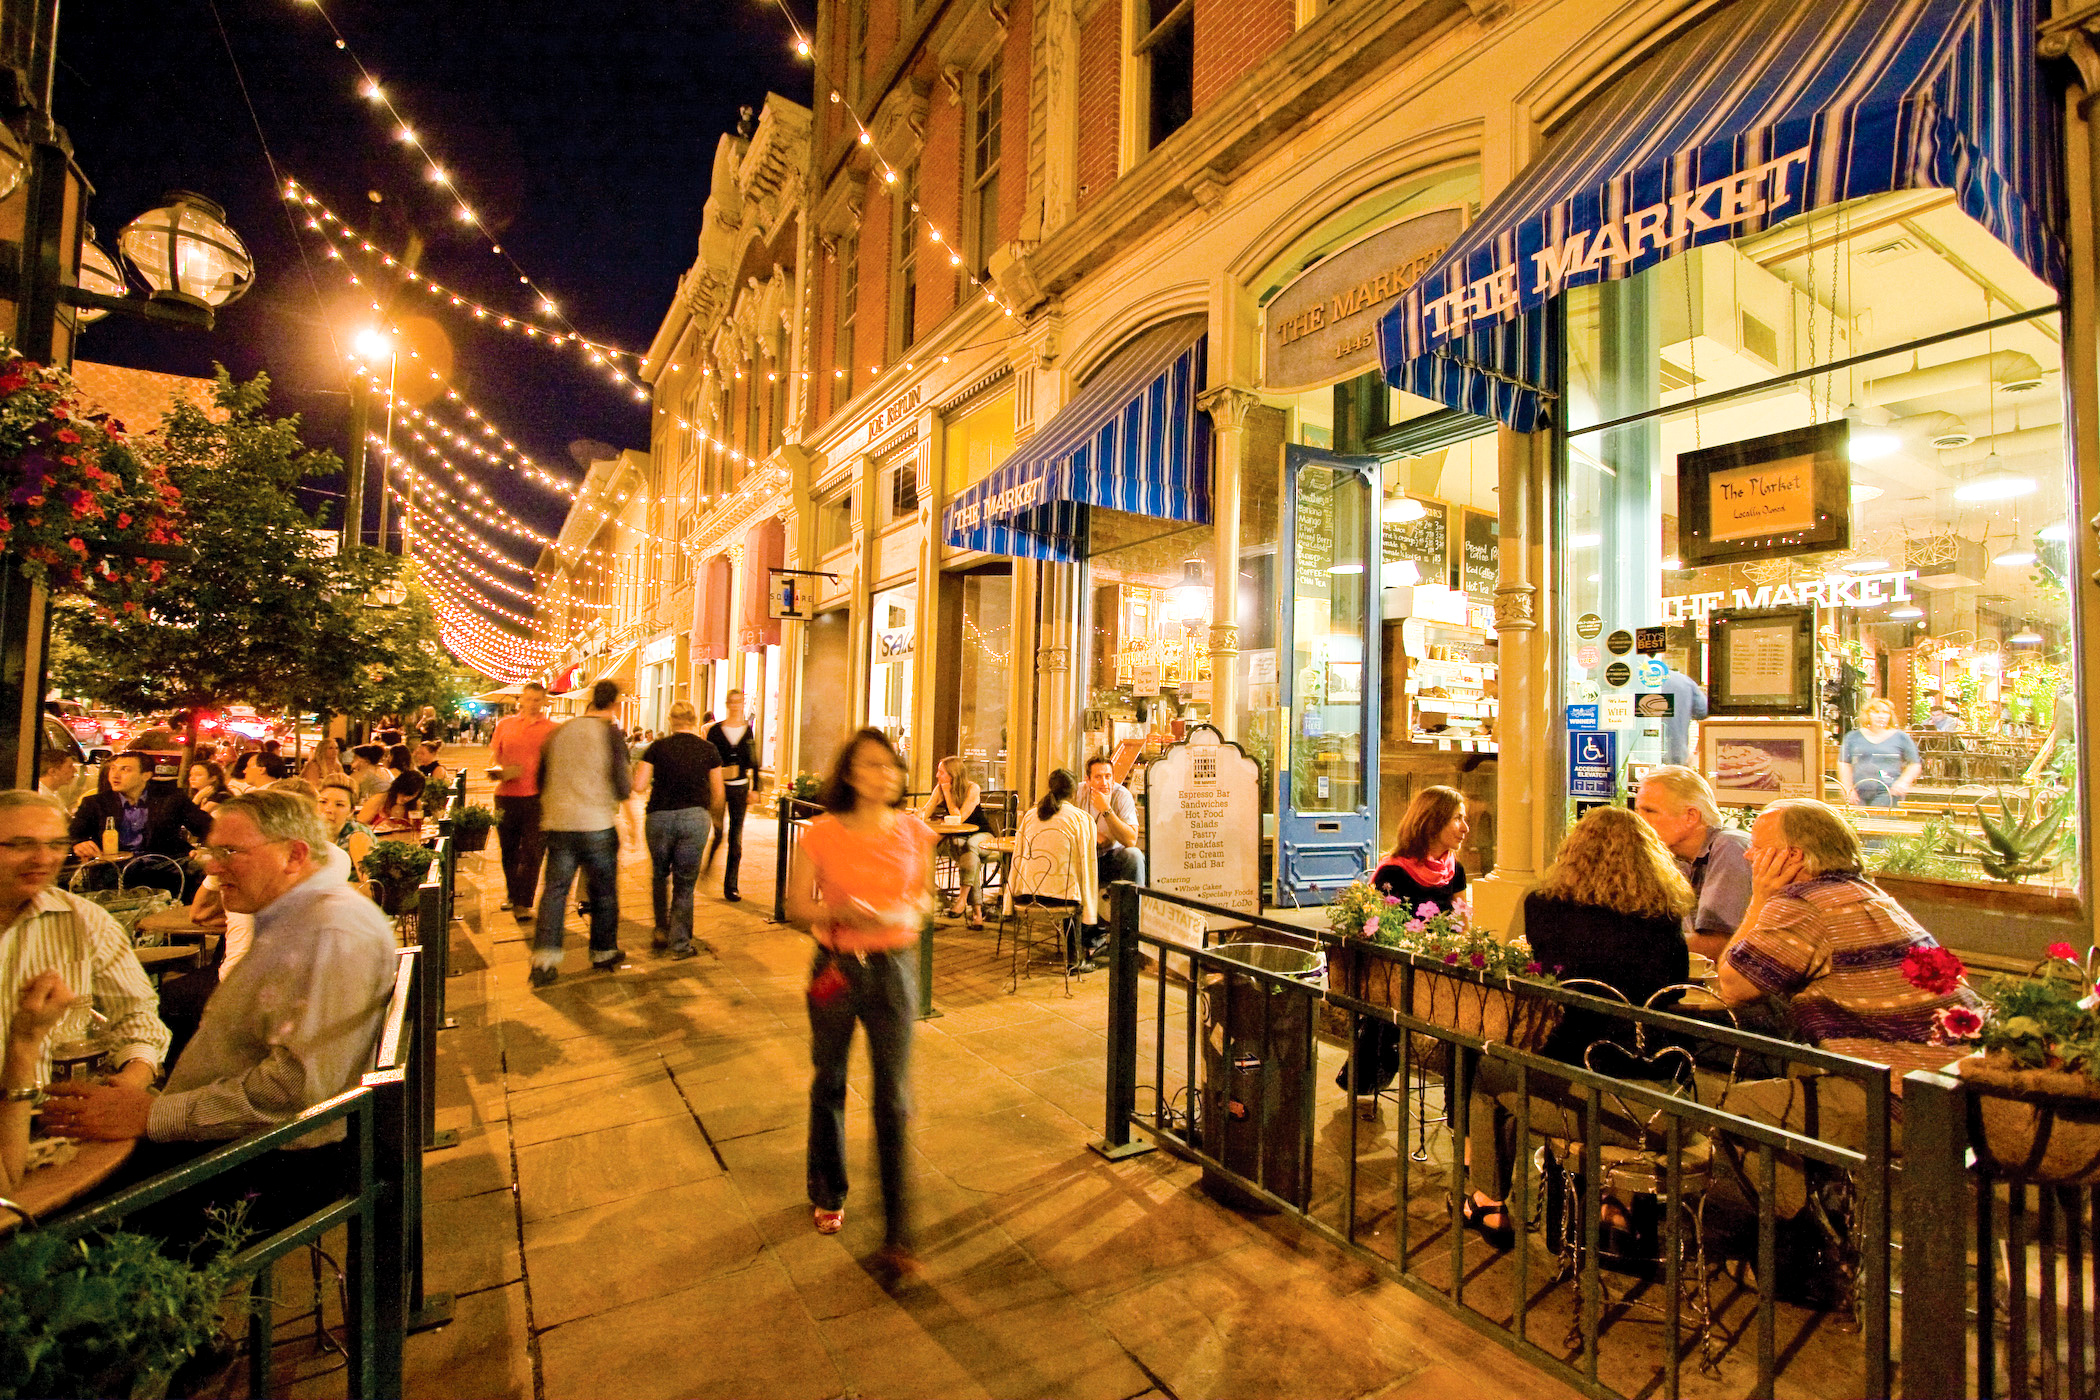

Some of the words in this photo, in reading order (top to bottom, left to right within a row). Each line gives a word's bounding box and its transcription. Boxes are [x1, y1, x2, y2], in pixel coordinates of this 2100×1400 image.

[1424, 263, 1517, 339] THE
[1531, 146, 1810, 295] MARKET
[1278, 302, 1326, 347] THE
[1336, 331, 1373, 359] 1445
[1720, 482, 1744, 501] The
[1749, 475, 1800, 496] Market
[955, 502, 980, 530] THE
[983, 476, 1042, 520] MARKET
[1299, 504, 1322, 516] Banana
[1733, 505, 1761, 519] Locally
[1763, 504, 1786, 515] Owned
[1299, 515, 1321, 528] Mango
[1466, 581, 1477, 592] Hot
[1479, 582, 1488, 594] Tea
[780, 579, 802, 616] 1
[1660, 590, 1724, 624] THE
[1732, 570, 1918, 610] MARKET
[1638, 632, 1664, 641] CITY'S
[1638, 640, 1664, 649] BEST
[1178, 790, 1213, 800] Espresso
[1217, 790, 1230, 798] Bar
[1180, 801, 1228, 809] Sandwiches
[1204, 810, 1224, 818] Food
[1191, 820, 1218, 828] Salads
[1192, 831, 1216, 839] Pastry
[1185, 840, 1224, 849] Breakfast
[1185, 851, 1196, 859] Ice
[1199, 850, 1224, 858] Cream
[1184, 861, 1207, 869] Salad
[1211, 860, 1224, 868] Bar
[1201, 890, 1232, 899] Specialty
[1235, 888, 1253, 896] Foods
[1232, 899, 1252, 907] LoDo
